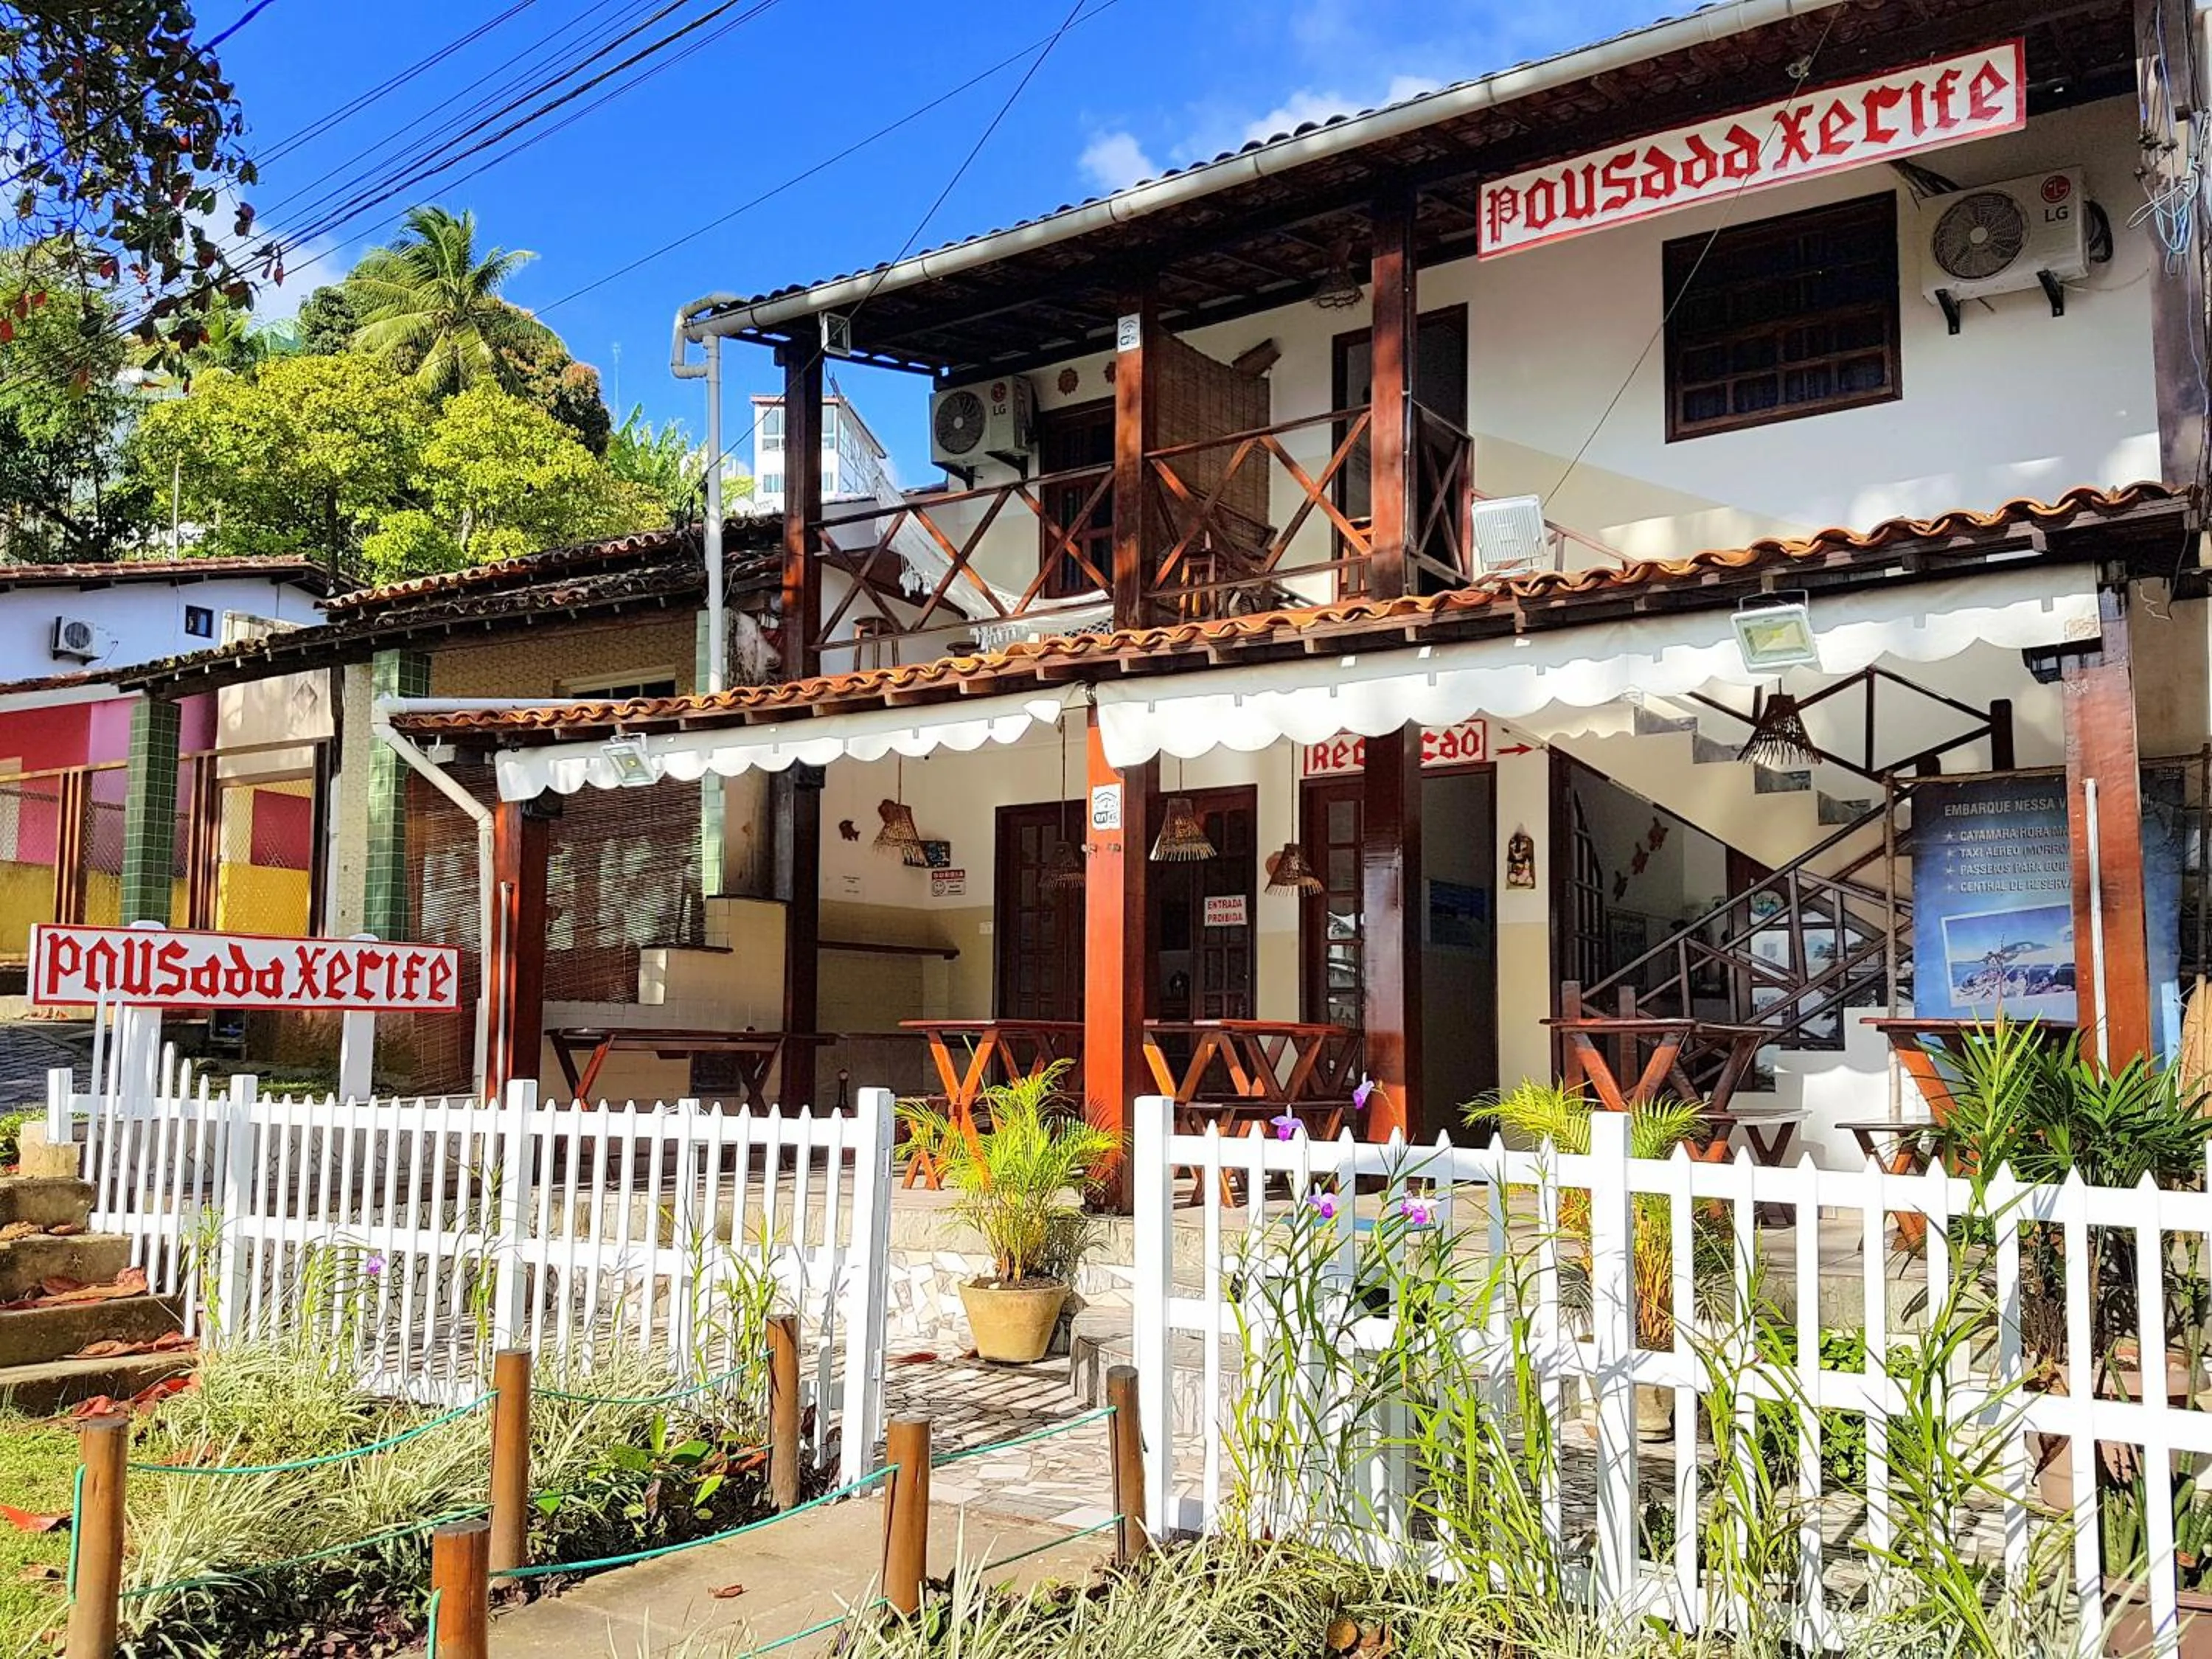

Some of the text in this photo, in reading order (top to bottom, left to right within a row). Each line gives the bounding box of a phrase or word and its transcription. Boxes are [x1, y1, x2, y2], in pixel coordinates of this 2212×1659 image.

[2045, 206, 2068, 223] LG
[992, 404, 1006, 416] LG
[1944, 800, 2011, 817] EMBARQUE
[2014, 797, 2054, 811] NESSA
[1208, 899, 1242, 909] ENTRADA
